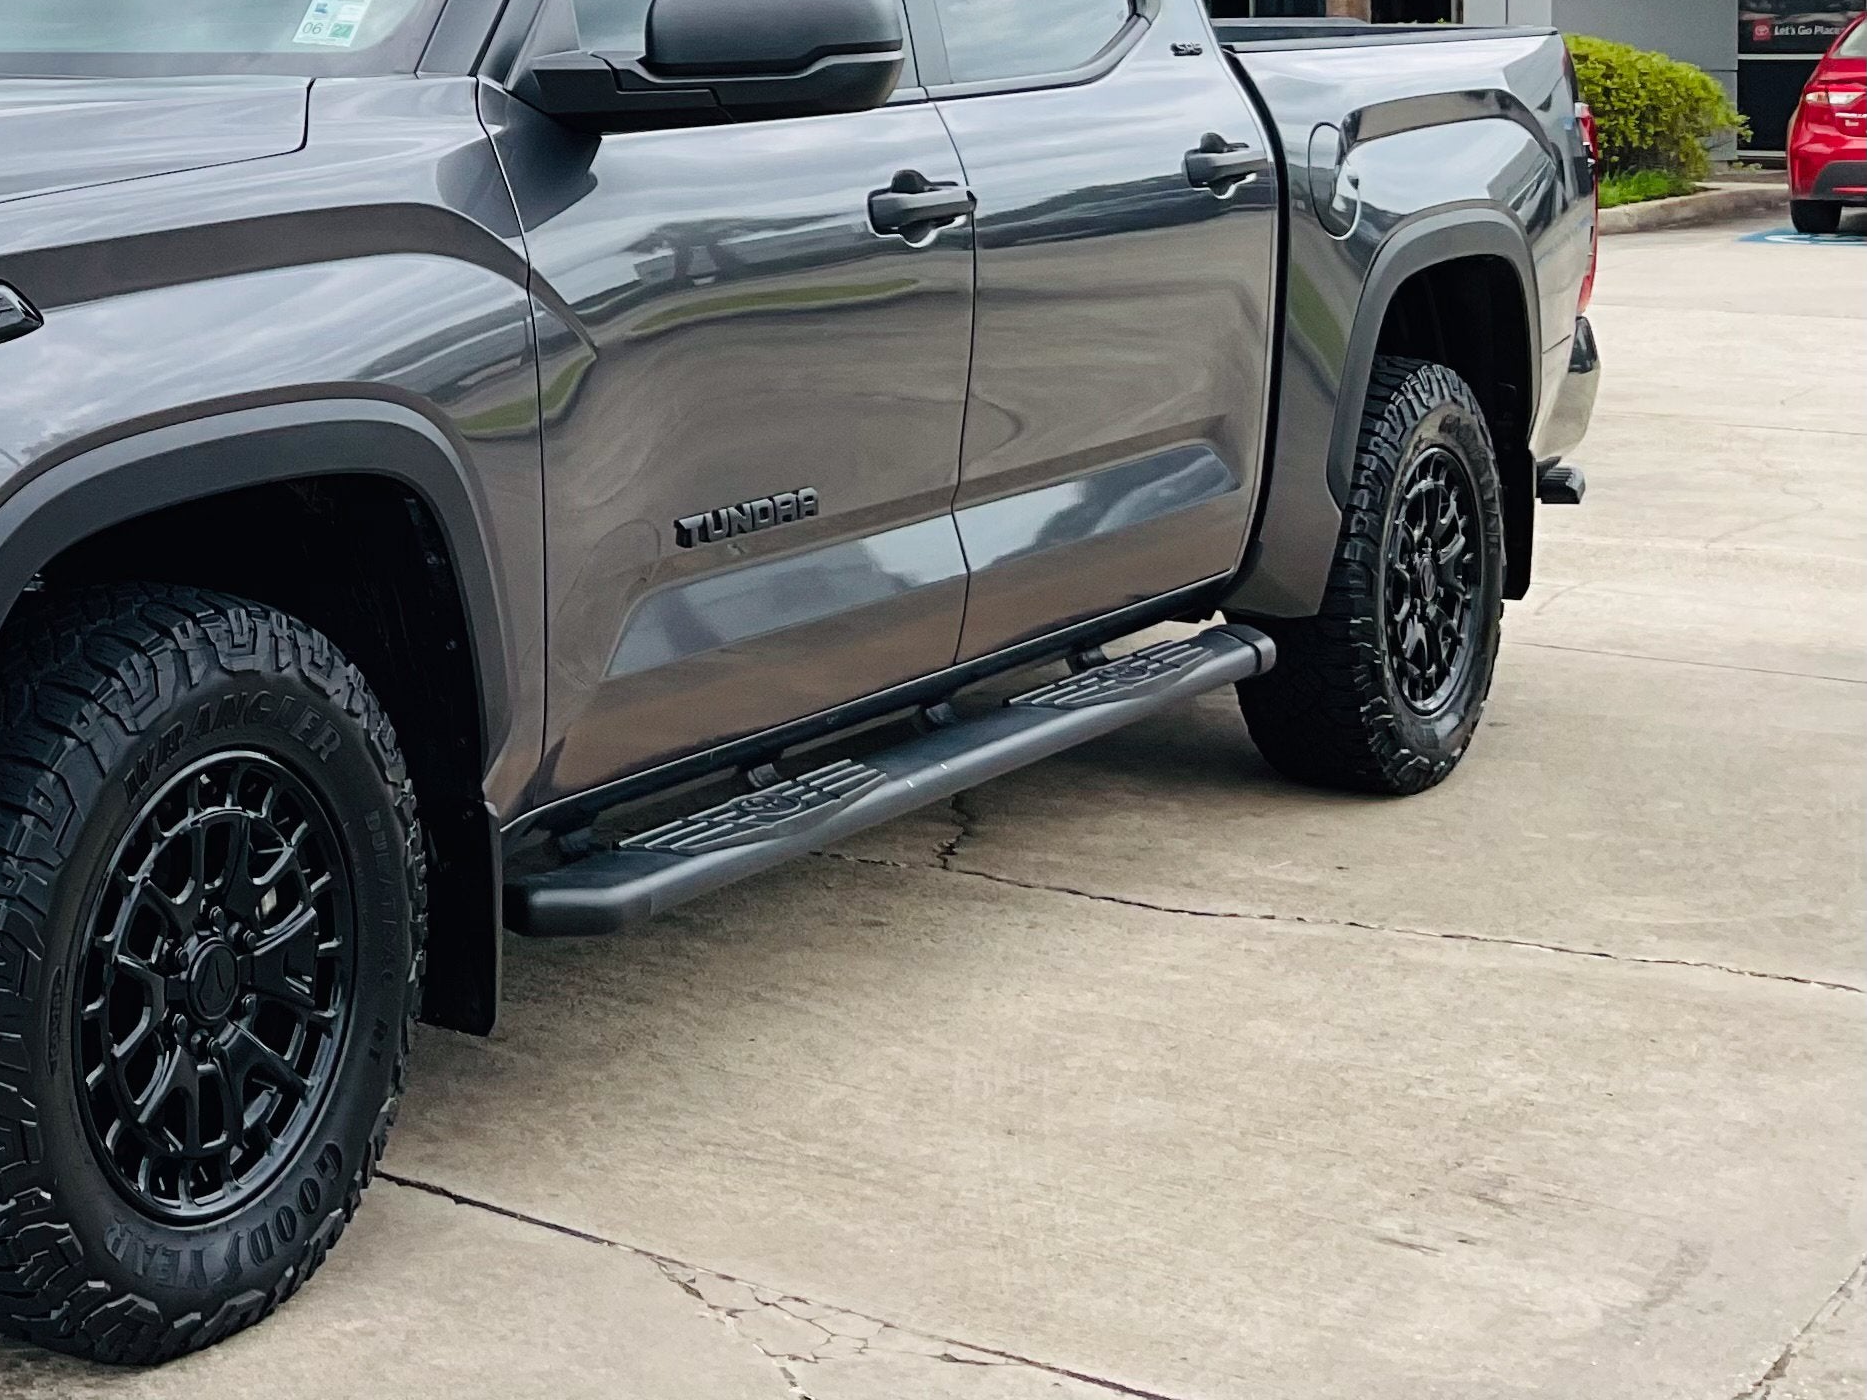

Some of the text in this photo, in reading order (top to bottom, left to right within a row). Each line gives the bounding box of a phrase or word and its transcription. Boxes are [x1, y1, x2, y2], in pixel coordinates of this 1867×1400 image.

[302, 22, 324, 34] 06
[1774, 25, 1795, 36] Let's
[1797, 25, 1813, 36] Go
[674, 486, 819, 548] TUNDRA
[122, 690, 342, 804] WRANGLER
[103, 1143, 343, 1290] GOODYEAR
